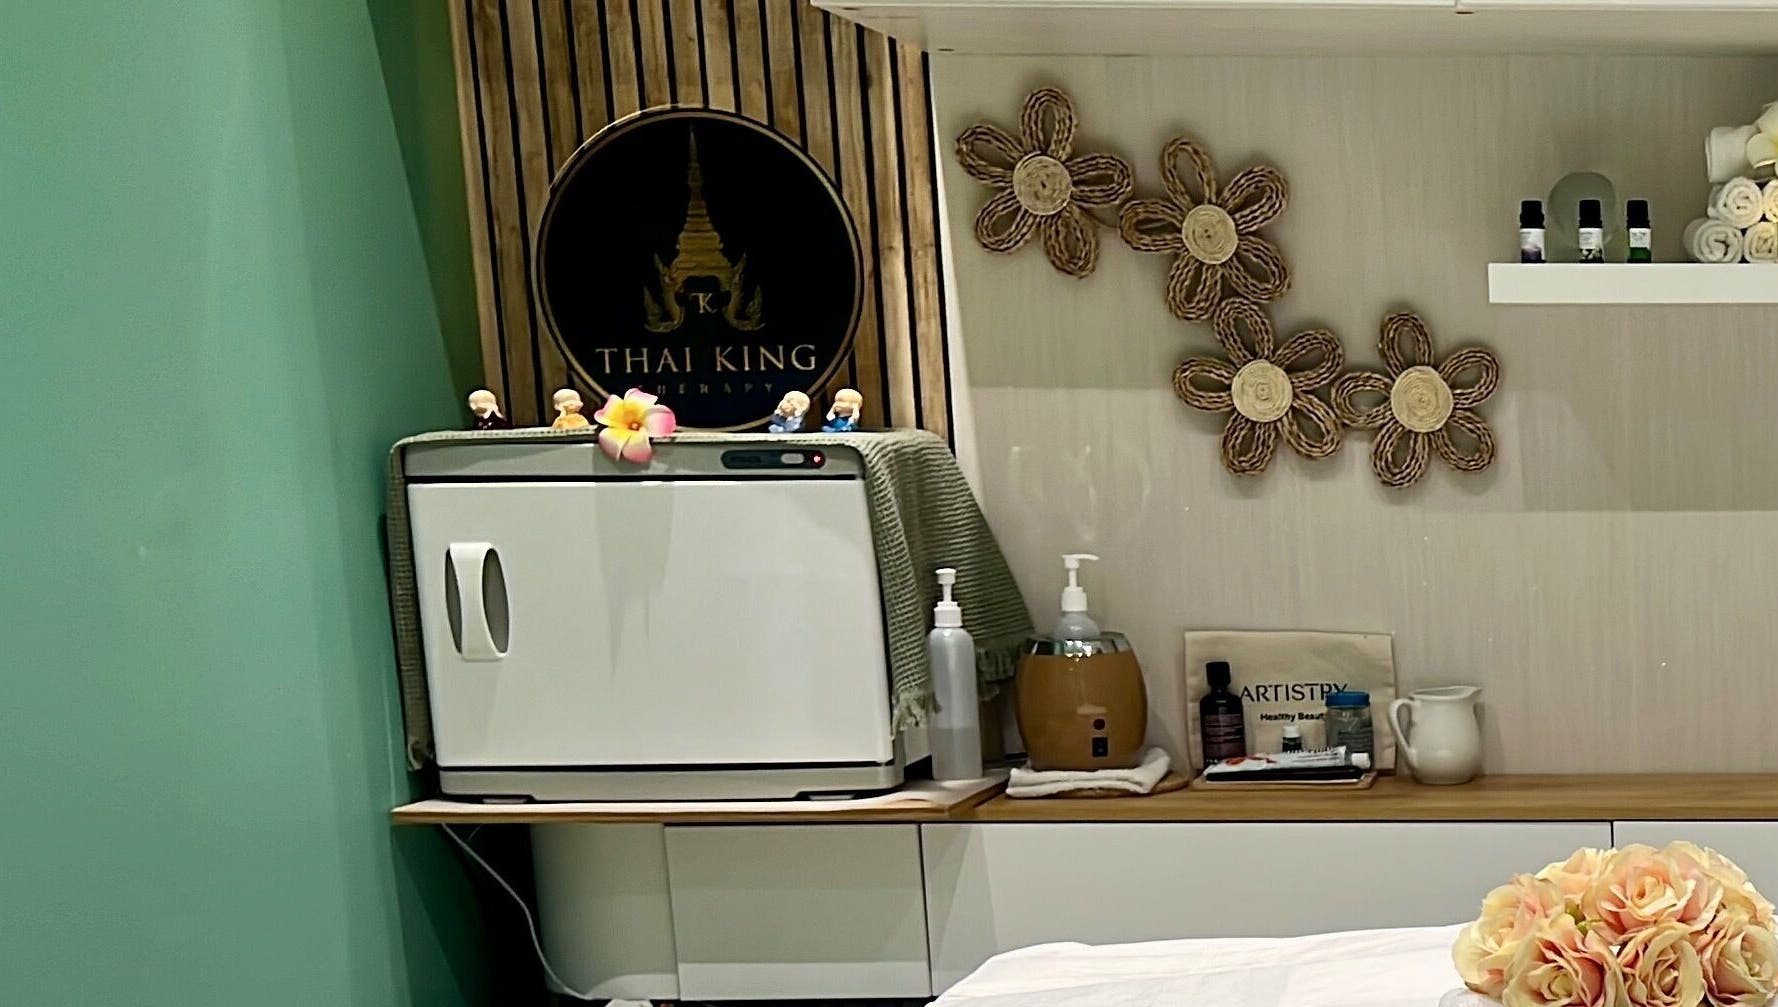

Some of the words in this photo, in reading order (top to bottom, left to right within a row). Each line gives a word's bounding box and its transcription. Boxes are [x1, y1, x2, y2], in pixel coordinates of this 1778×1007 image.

[595, 346, 692, 374] THAI
[715, 344, 816, 372] KING
[637, 382, 773, 395] HERAPY
[1240, 683, 1347, 702] ARTISTRY
[1260, 712, 1296, 722] Healthy
[1298, 712, 1325, 721] Beaut
